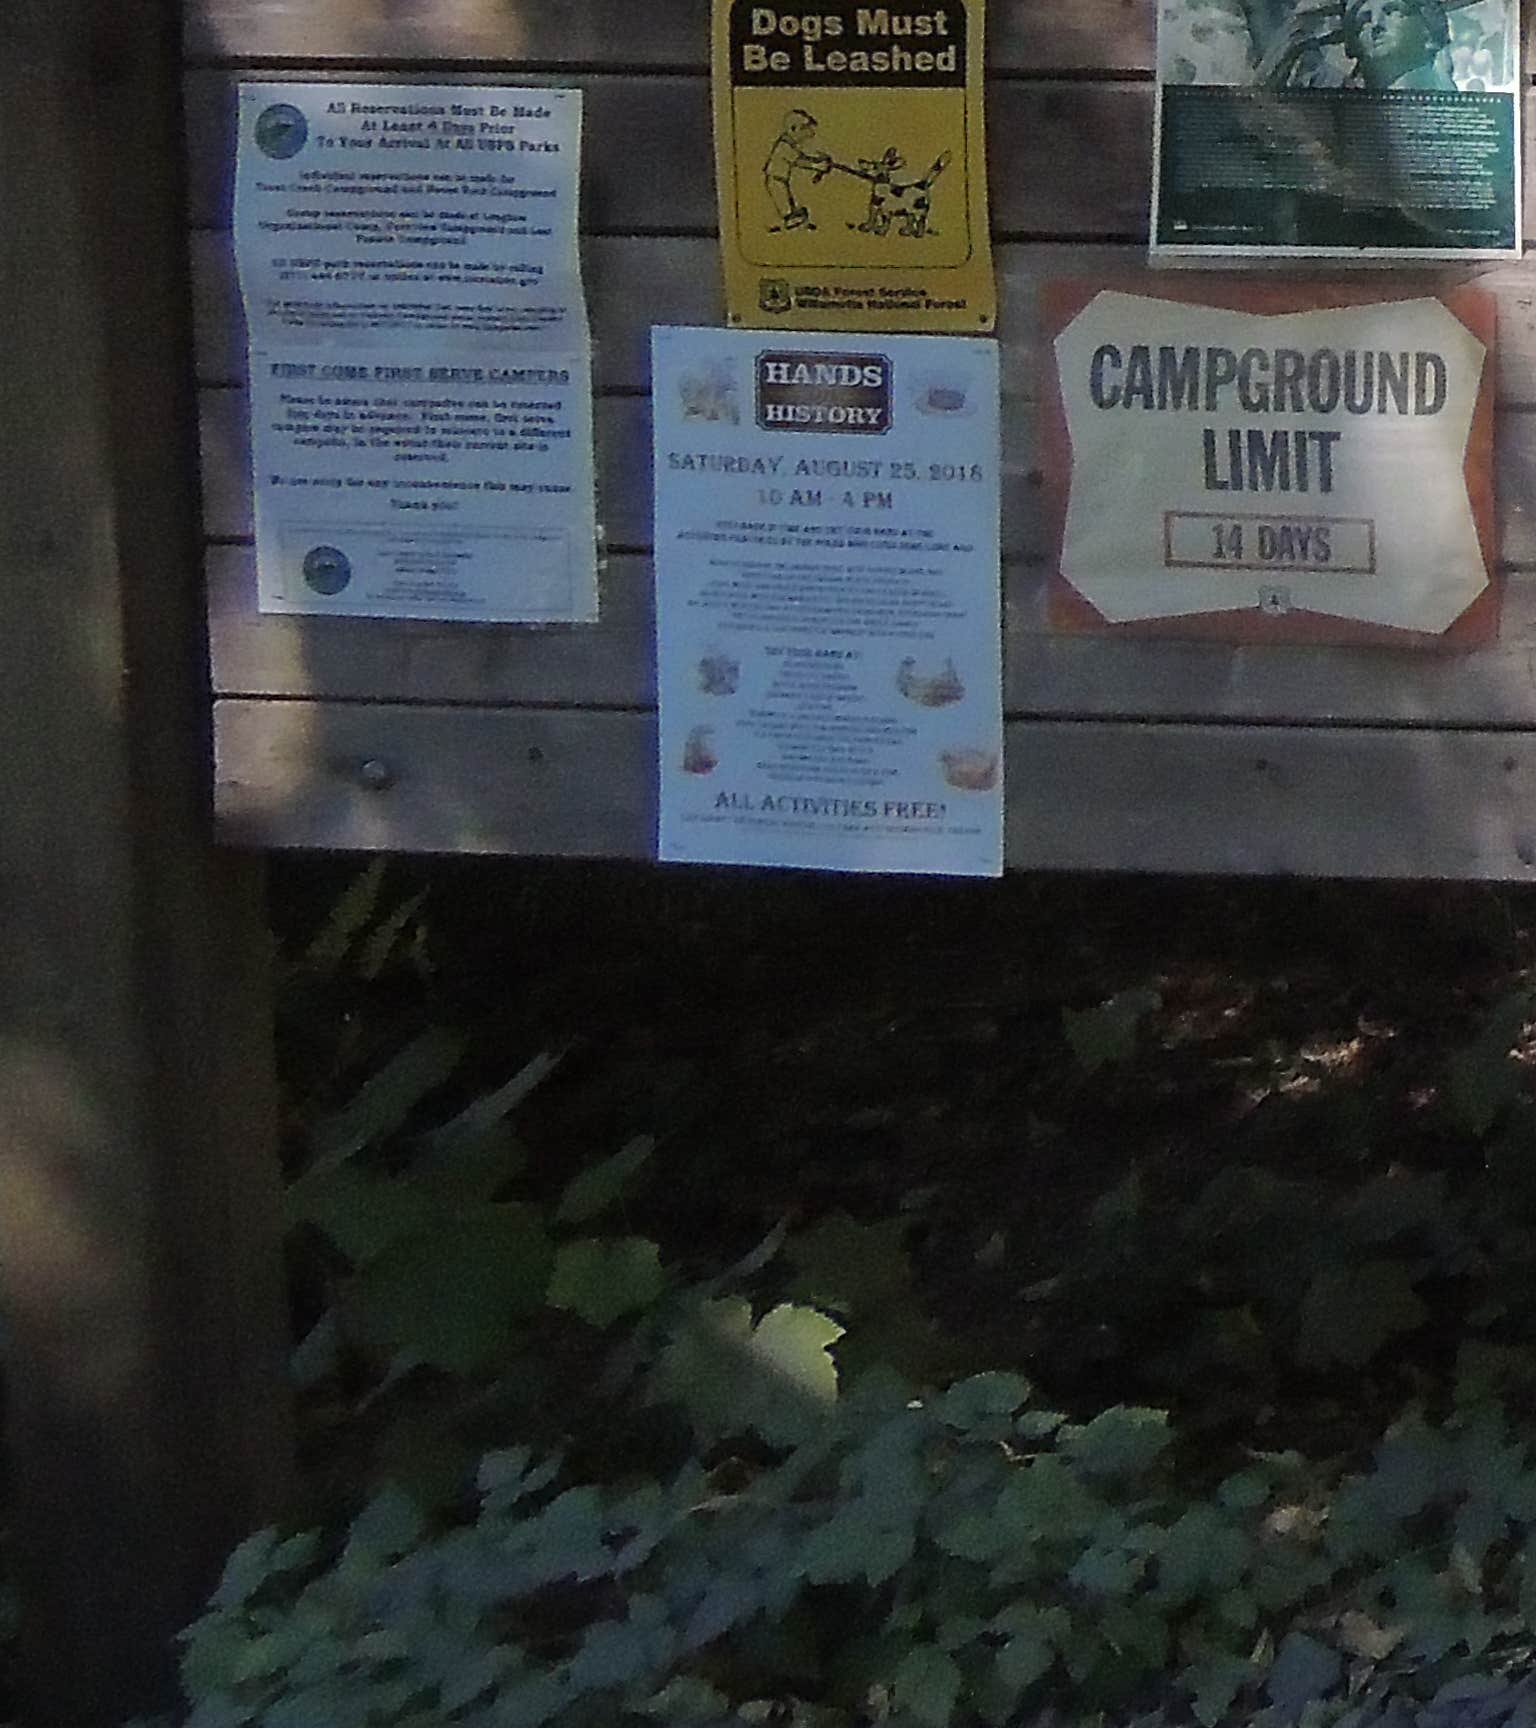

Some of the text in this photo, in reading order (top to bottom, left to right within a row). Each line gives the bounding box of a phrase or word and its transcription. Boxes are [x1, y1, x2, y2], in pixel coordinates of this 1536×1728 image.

[752, 8, 949, 41] Dogs Must
[743, 44, 956, 72] Be Leashed
[766, 362, 883, 388] HANDS
[1089, 343, 1448, 416] CAMPGROUND
[765, 403, 884, 424] HISTORY
[795, 459, 882, 479] AUGUST
[1202, 428, 1342, 494] LIMIT
[758, 489, 893, 510] 10 AM 4 PM
[1212, 523, 1332, 563] 14 DAYS
[714, 792, 947, 821] ALL ACTIVITIES FREE!
